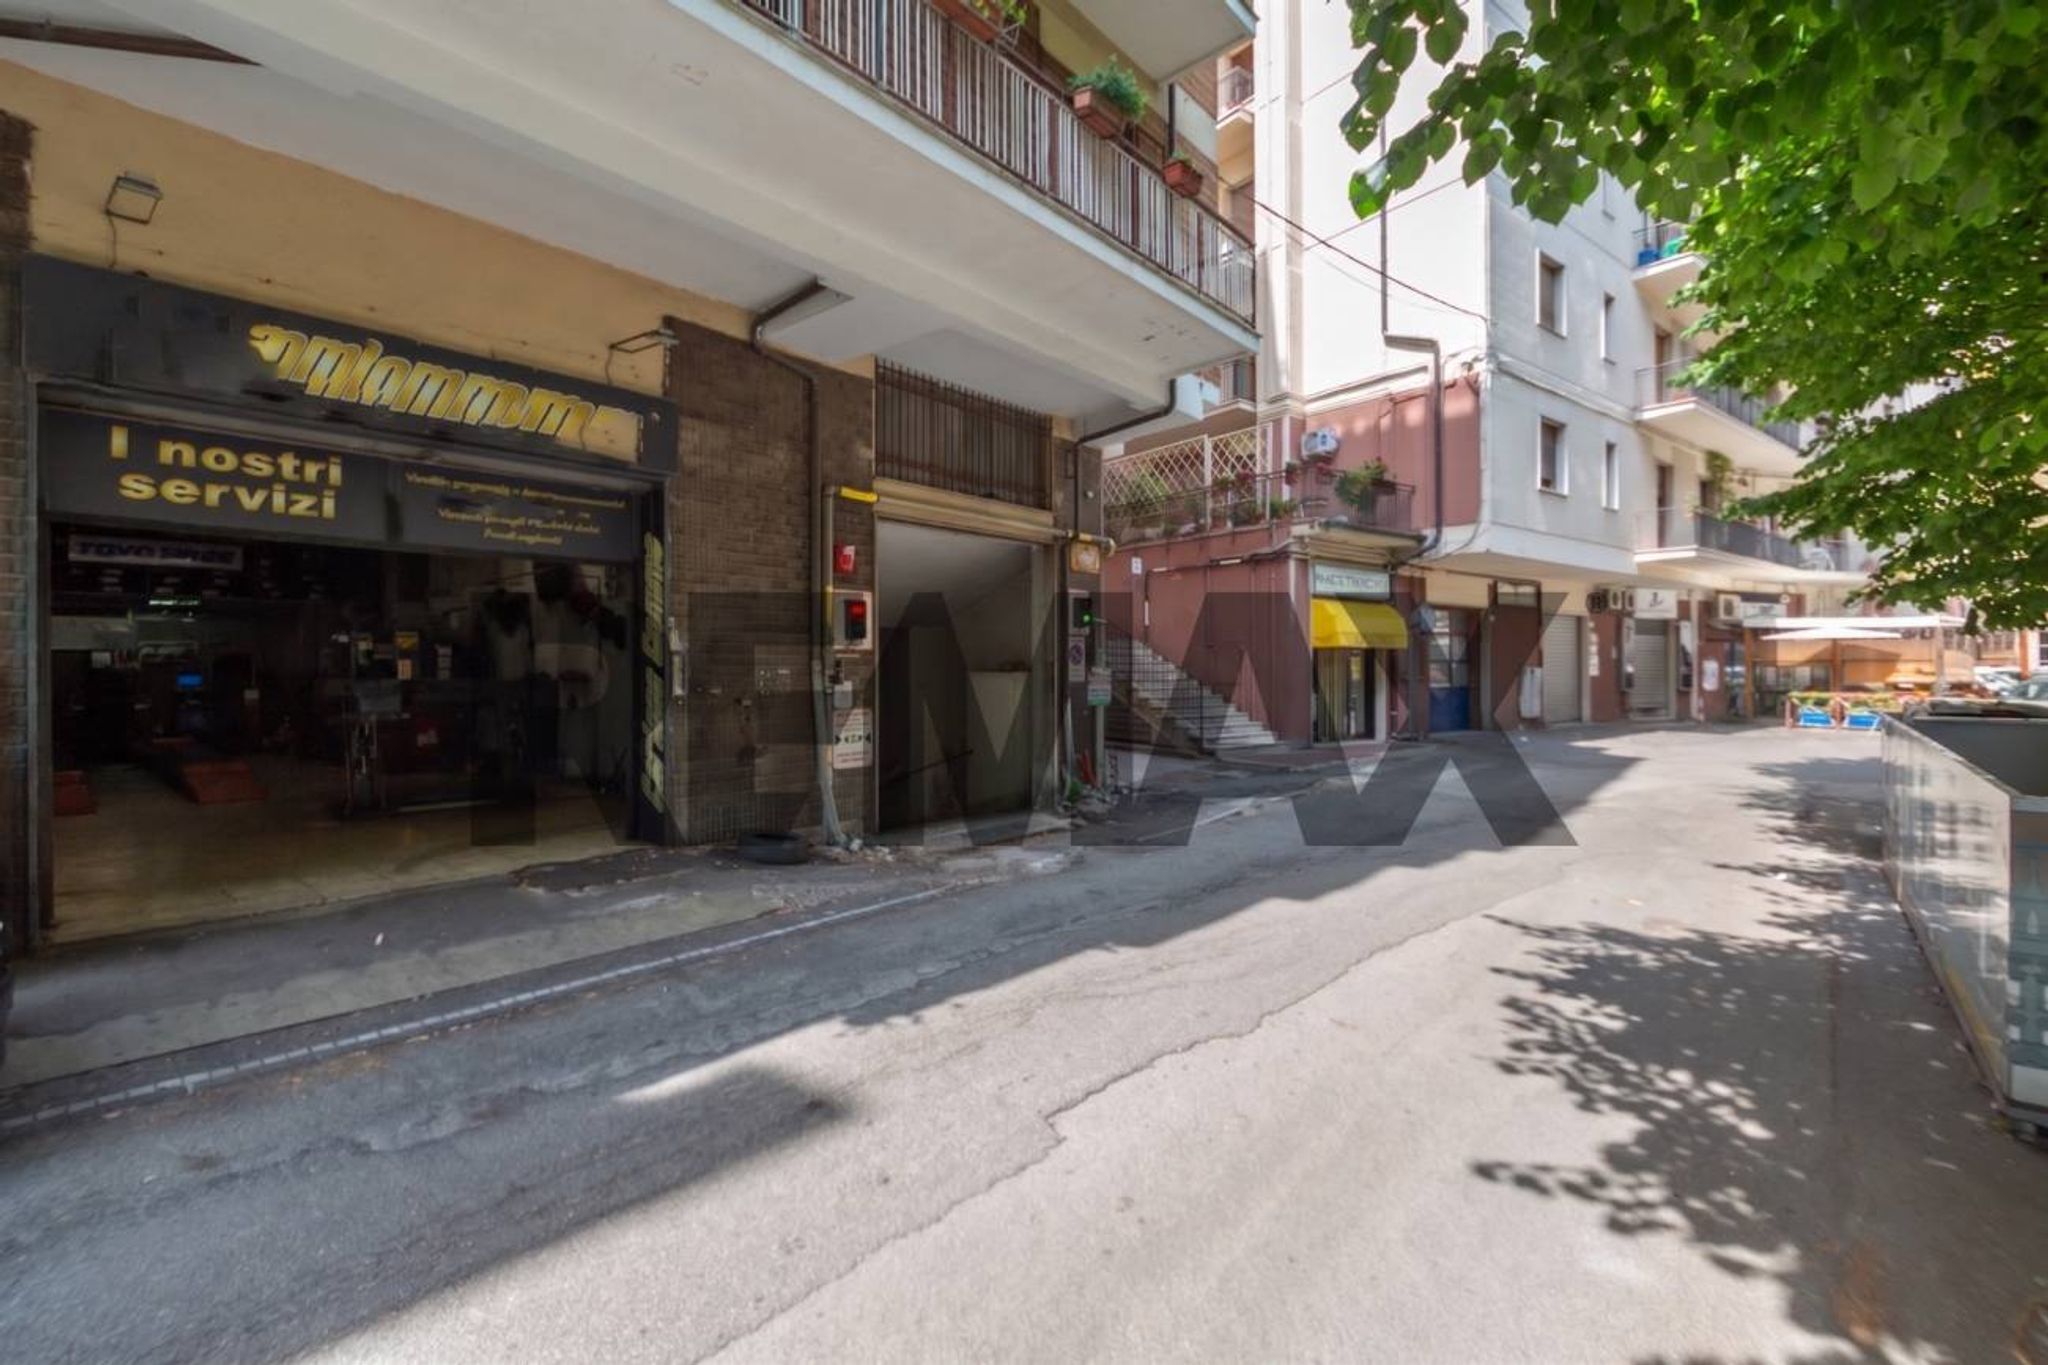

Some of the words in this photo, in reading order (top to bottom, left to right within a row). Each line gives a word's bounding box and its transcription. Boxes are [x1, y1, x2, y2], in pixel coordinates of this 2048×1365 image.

[110, 425, 129, 460] I
[158, 440, 343, 487] nostri
[118, 472, 337, 520] servizi
